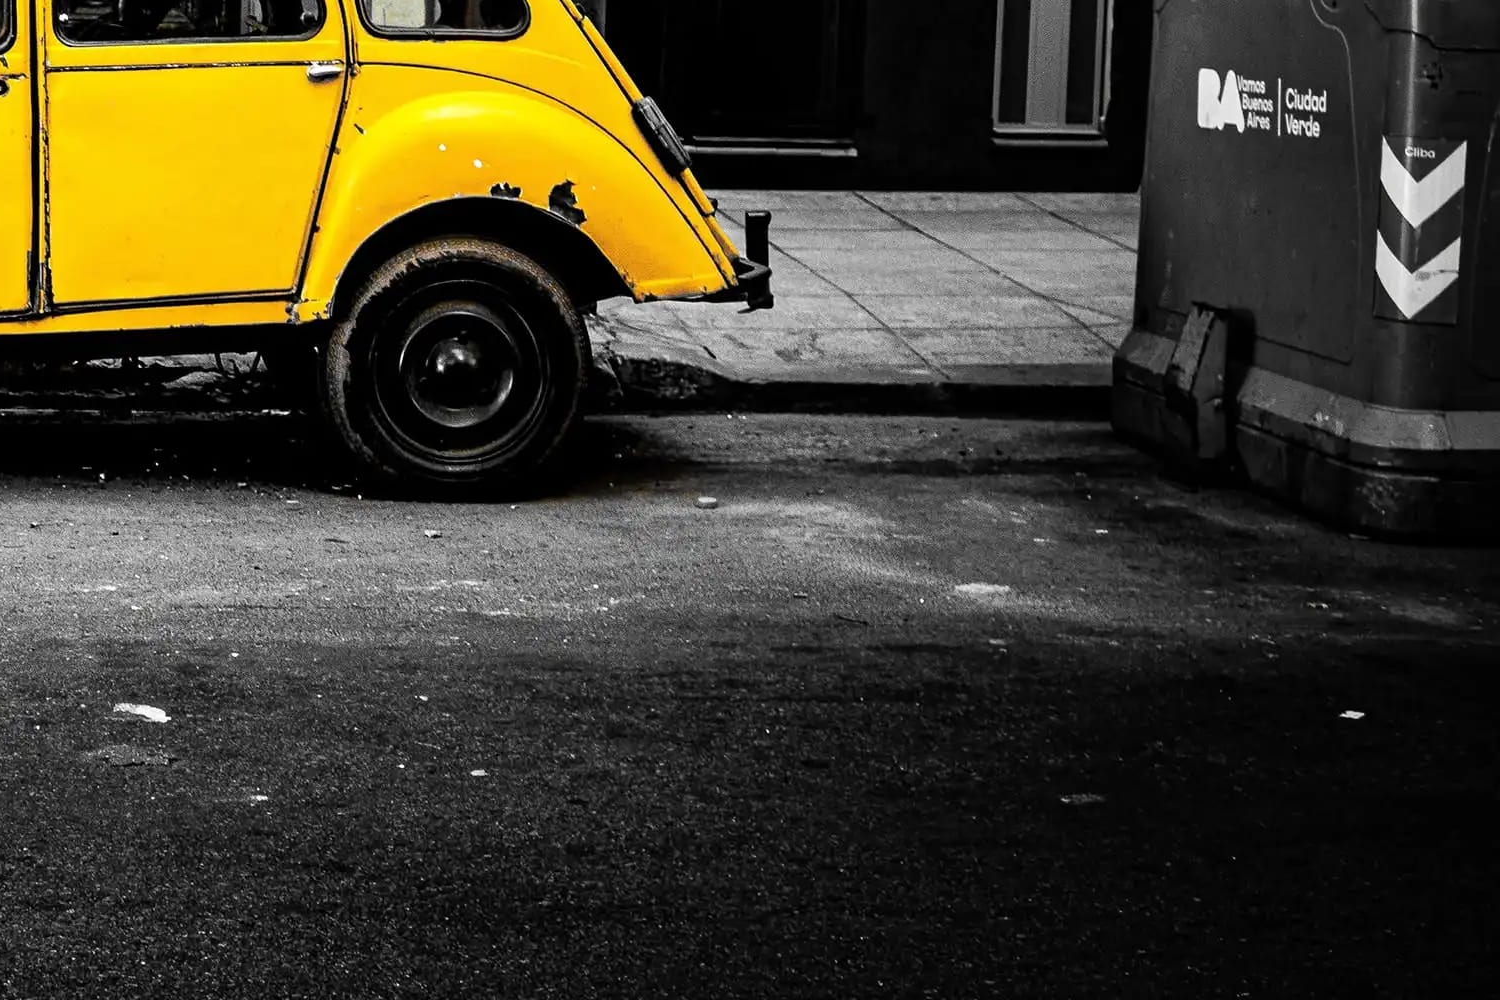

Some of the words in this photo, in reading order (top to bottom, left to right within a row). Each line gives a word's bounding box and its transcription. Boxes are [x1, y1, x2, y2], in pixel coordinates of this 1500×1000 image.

[1237, 75, 1266, 95] Vamos
[1241, 93, 1273, 113] Buenos
[1285, 87, 1327, 113] Ciudad
[1246, 112, 1271, 131] Aires
[1284, 113, 1320, 138] Verde
[1404, 146, 1436, 158] Cliba
